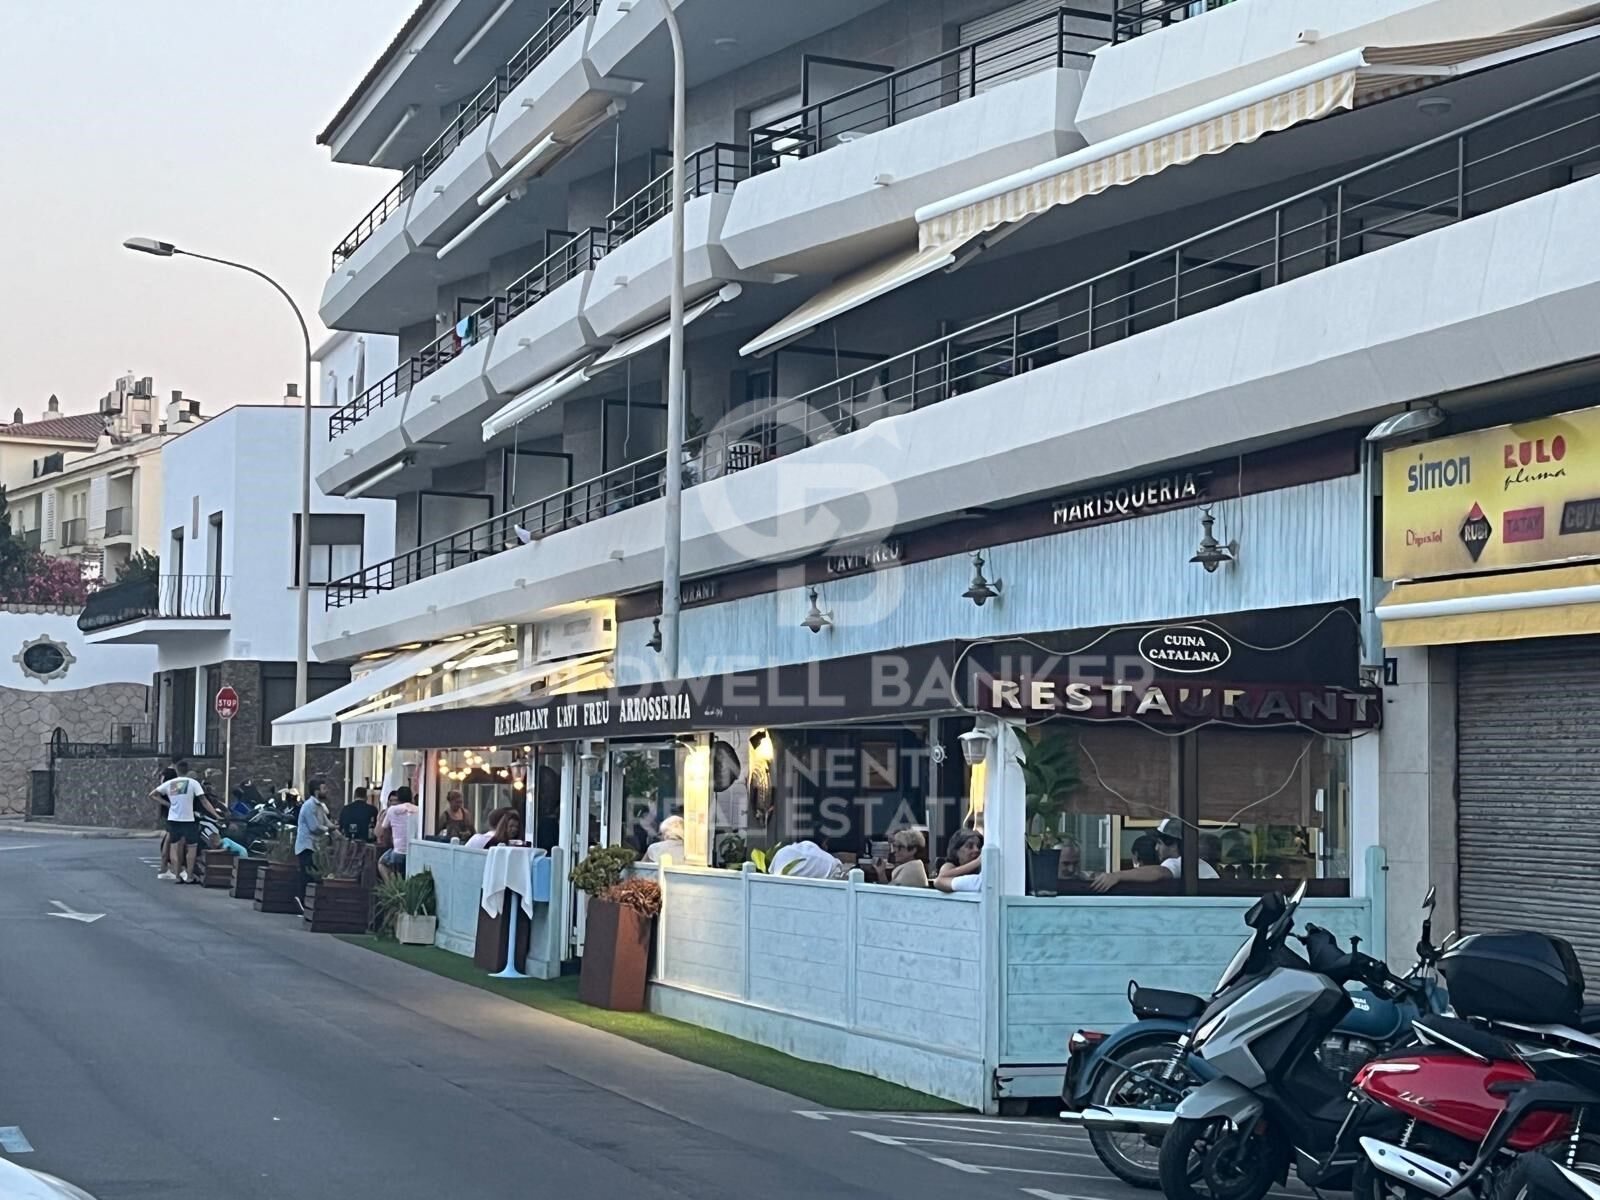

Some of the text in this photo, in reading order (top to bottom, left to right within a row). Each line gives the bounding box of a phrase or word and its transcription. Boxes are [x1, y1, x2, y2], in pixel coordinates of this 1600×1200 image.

[1504, 435, 1566, 469] RULO
[1408, 453, 1471, 492] simon
[1504, 468, 1566, 491] pluma
[1053, 472, 1196, 525] MARISQUERIA
[1149, 649, 1220, 662] CATALANA
[1164, 635, 1205, 646] CUINA
[218, 699, 237, 707] STOP
[495, 709, 549, 737] RESTAURANT
[584, 700, 610, 726] FREU
[619, 693, 691, 722] ARROSSERIA
[992, 679, 1376, 721] RESTAURANT
